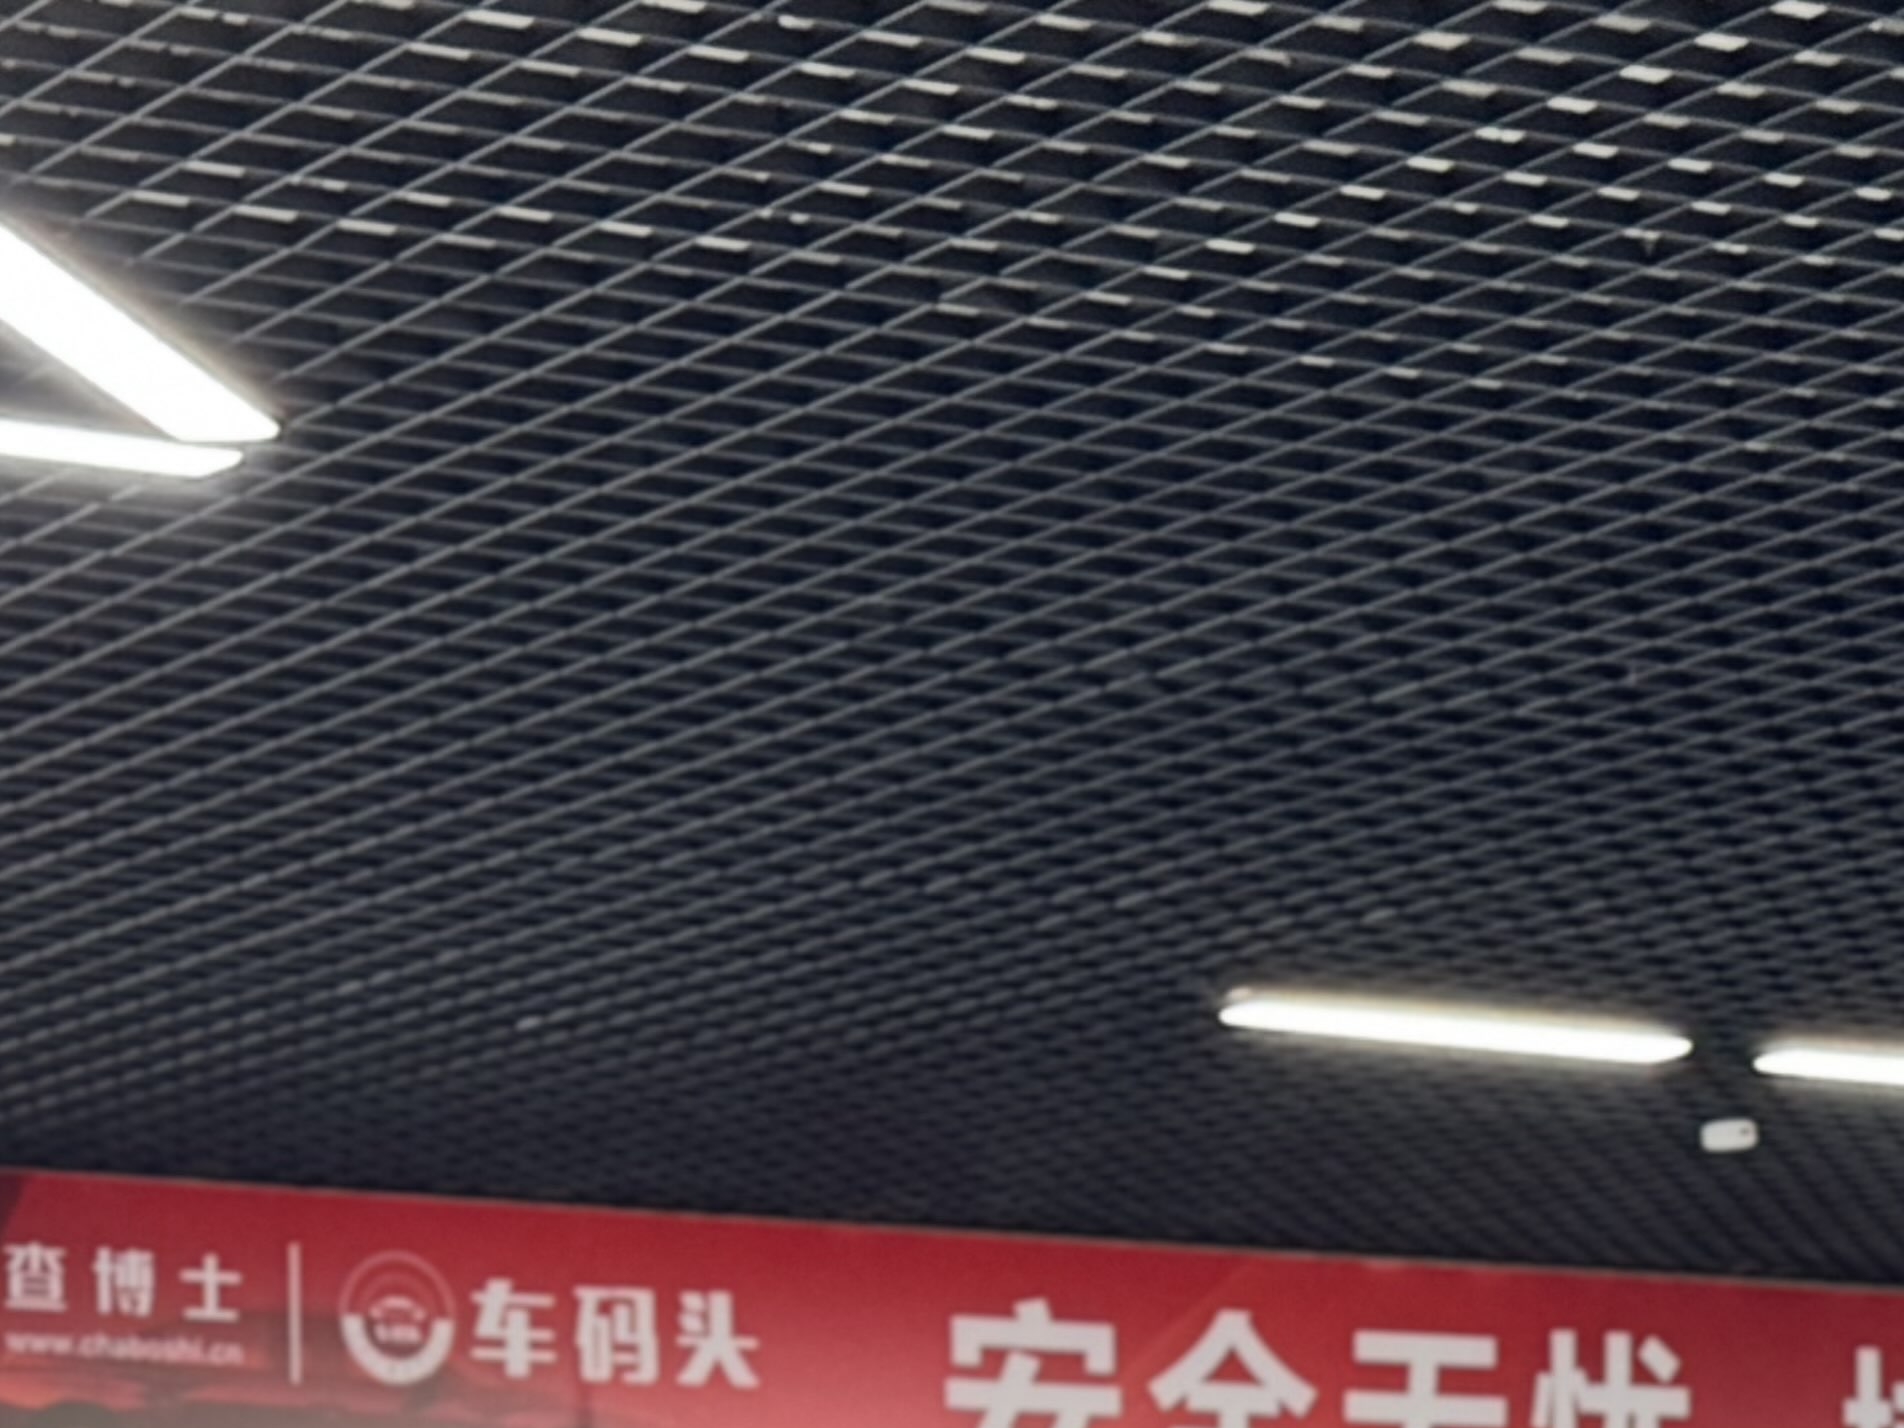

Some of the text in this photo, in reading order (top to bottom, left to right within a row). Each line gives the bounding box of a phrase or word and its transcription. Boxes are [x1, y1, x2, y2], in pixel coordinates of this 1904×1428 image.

[3, 1240, 243, 1323] 查博士
[470, 1277, 763, 1389] 车码头
